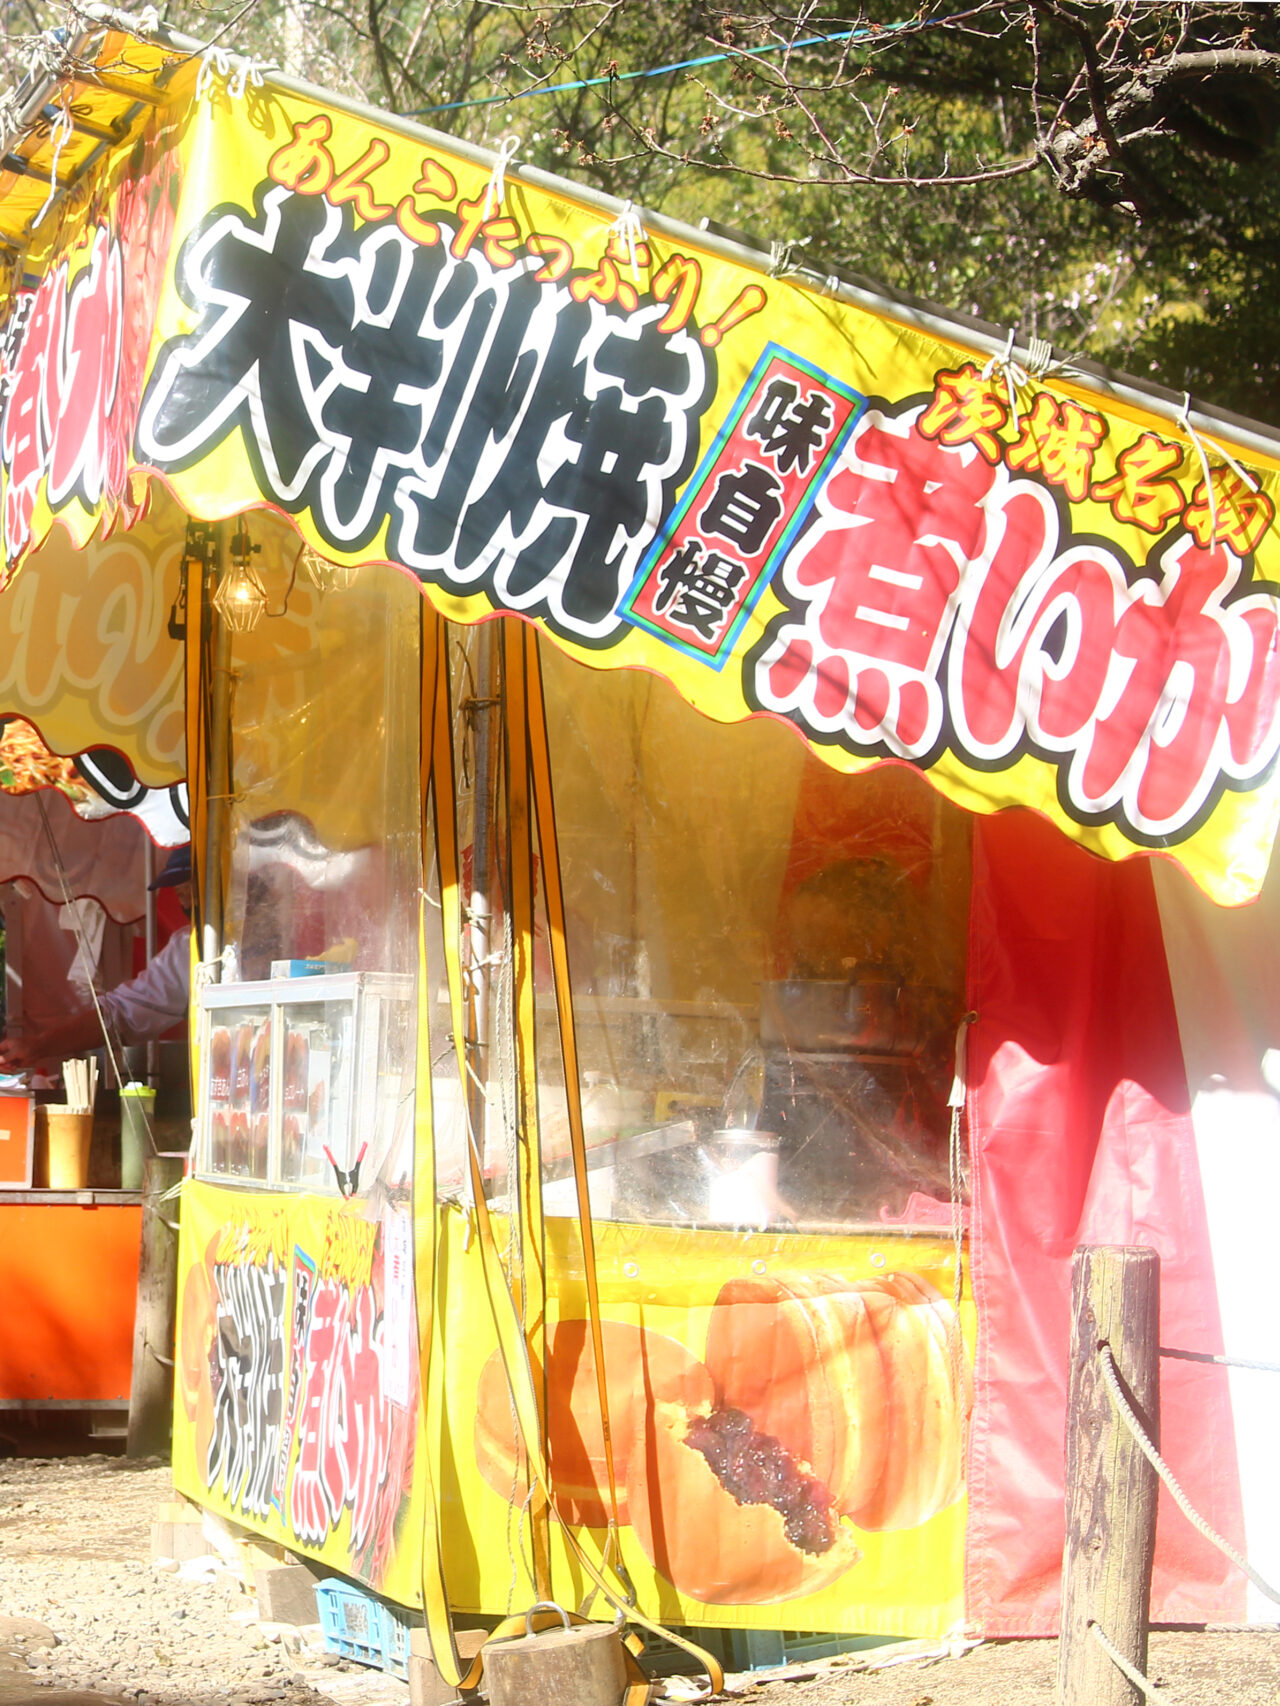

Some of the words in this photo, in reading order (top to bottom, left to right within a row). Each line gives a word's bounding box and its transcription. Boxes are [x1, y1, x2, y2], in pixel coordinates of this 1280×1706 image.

[269, 115, 766, 347] あんこたっぷり!
[133, 180, 717, 649] 大判焼
[651, 377, 837, 643] 味自慢
[916, 361, 1274, 555] 茨城名物
[744, 397, 1280, 851] 煮いか
